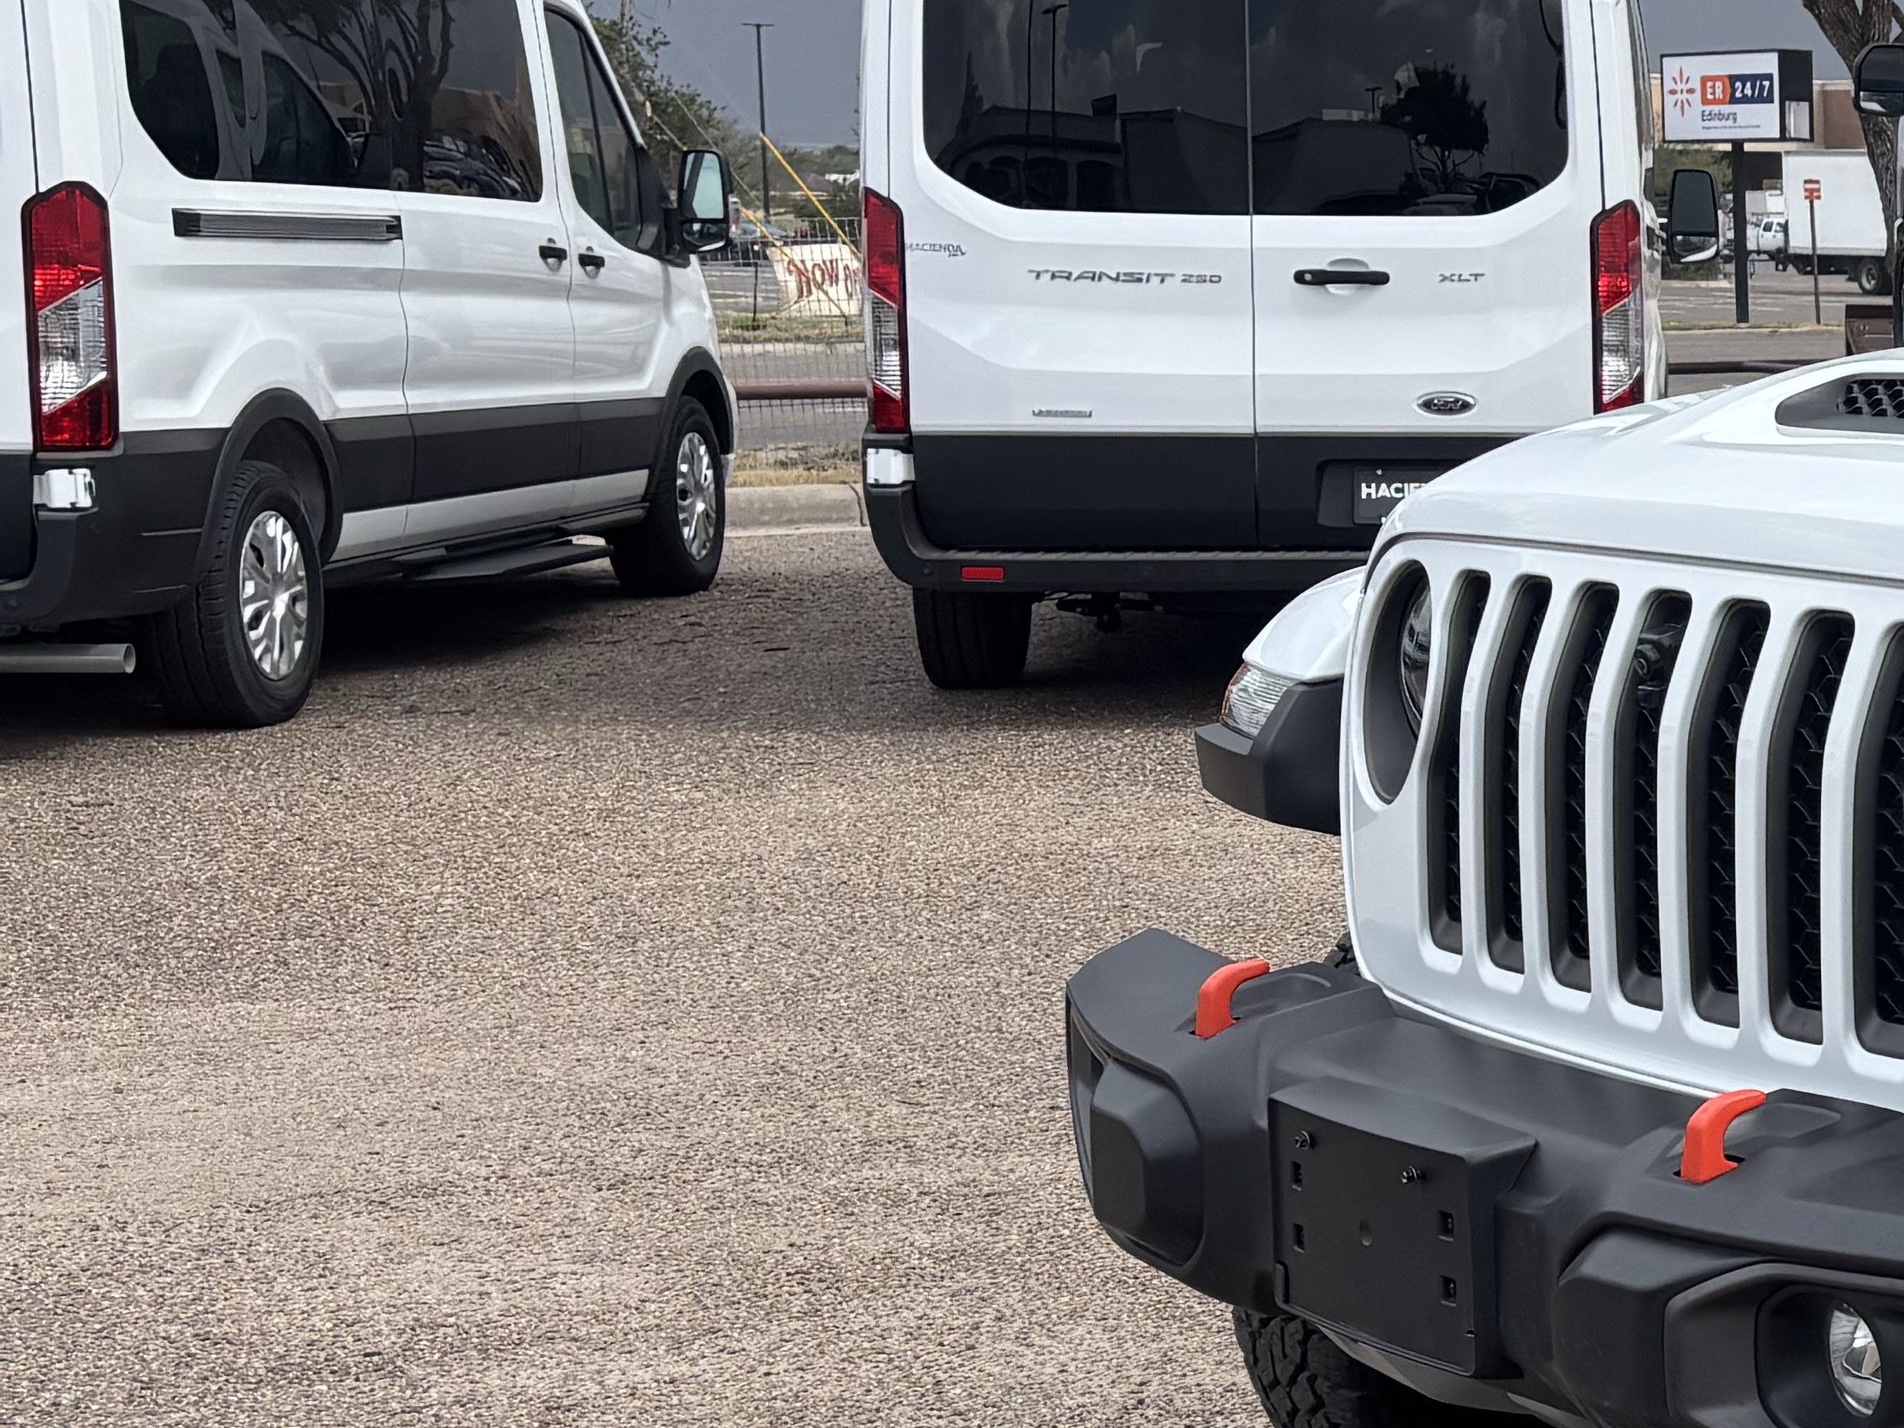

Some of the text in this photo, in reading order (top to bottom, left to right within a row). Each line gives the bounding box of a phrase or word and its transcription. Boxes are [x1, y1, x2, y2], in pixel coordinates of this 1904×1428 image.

[1706, 80, 1771, 100] ER 24/7
[1701, 109, 1738, 124] Edinburg
[1027, 269, 1223, 285] TRANSIT 250
[1438, 273, 1485, 283] XLT
[1360, 482, 1430, 500] HACIE
